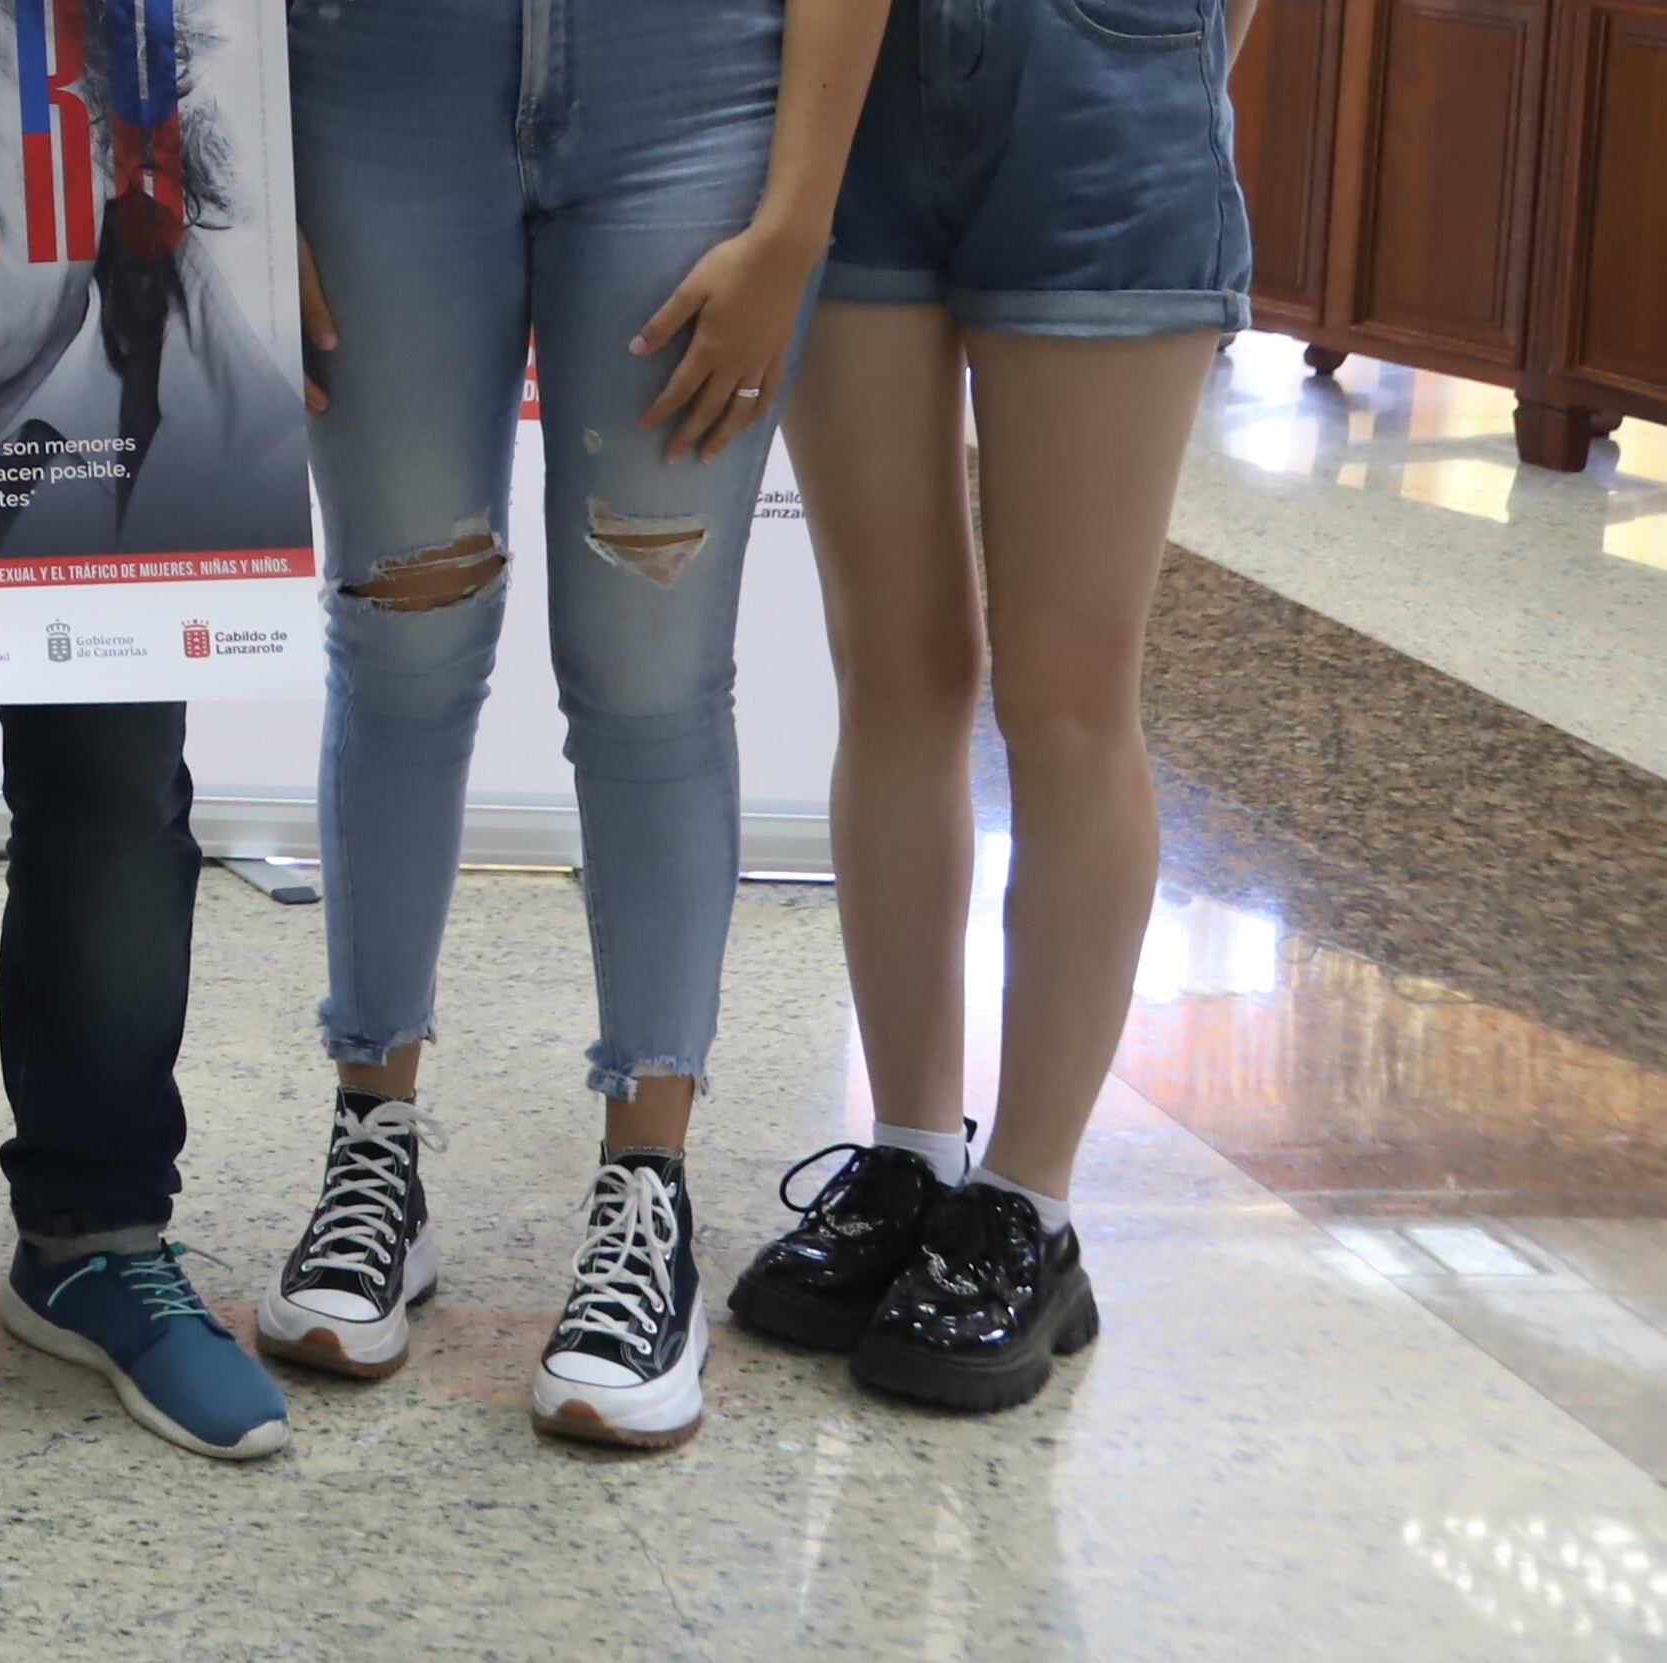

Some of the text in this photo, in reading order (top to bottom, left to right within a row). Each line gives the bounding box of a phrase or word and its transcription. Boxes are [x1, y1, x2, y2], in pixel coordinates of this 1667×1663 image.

[2, 441, 39, 456] son
[45, 437, 136, 454] menores
[50, 461, 130, 484] posible,
[39, 567, 47, 580] Y
[51, 566, 65, 581] EL
[68, 564, 117, 580] TRÁFICO
[120, 563, 136, 578] DE
[139, 561, 196, 577] MUJERES,
[200, 560, 237, 575] NIÑAS
[240, 559, 247, 573] Y
[251, 557, 291, 573] NIÑOS.
[76, 635, 135, 646] Gobierno
[214, 630, 288, 643] Cabildo de
[76, 646, 148, 658] de Canarias
[216, 642, 284, 655] Lanzarote
